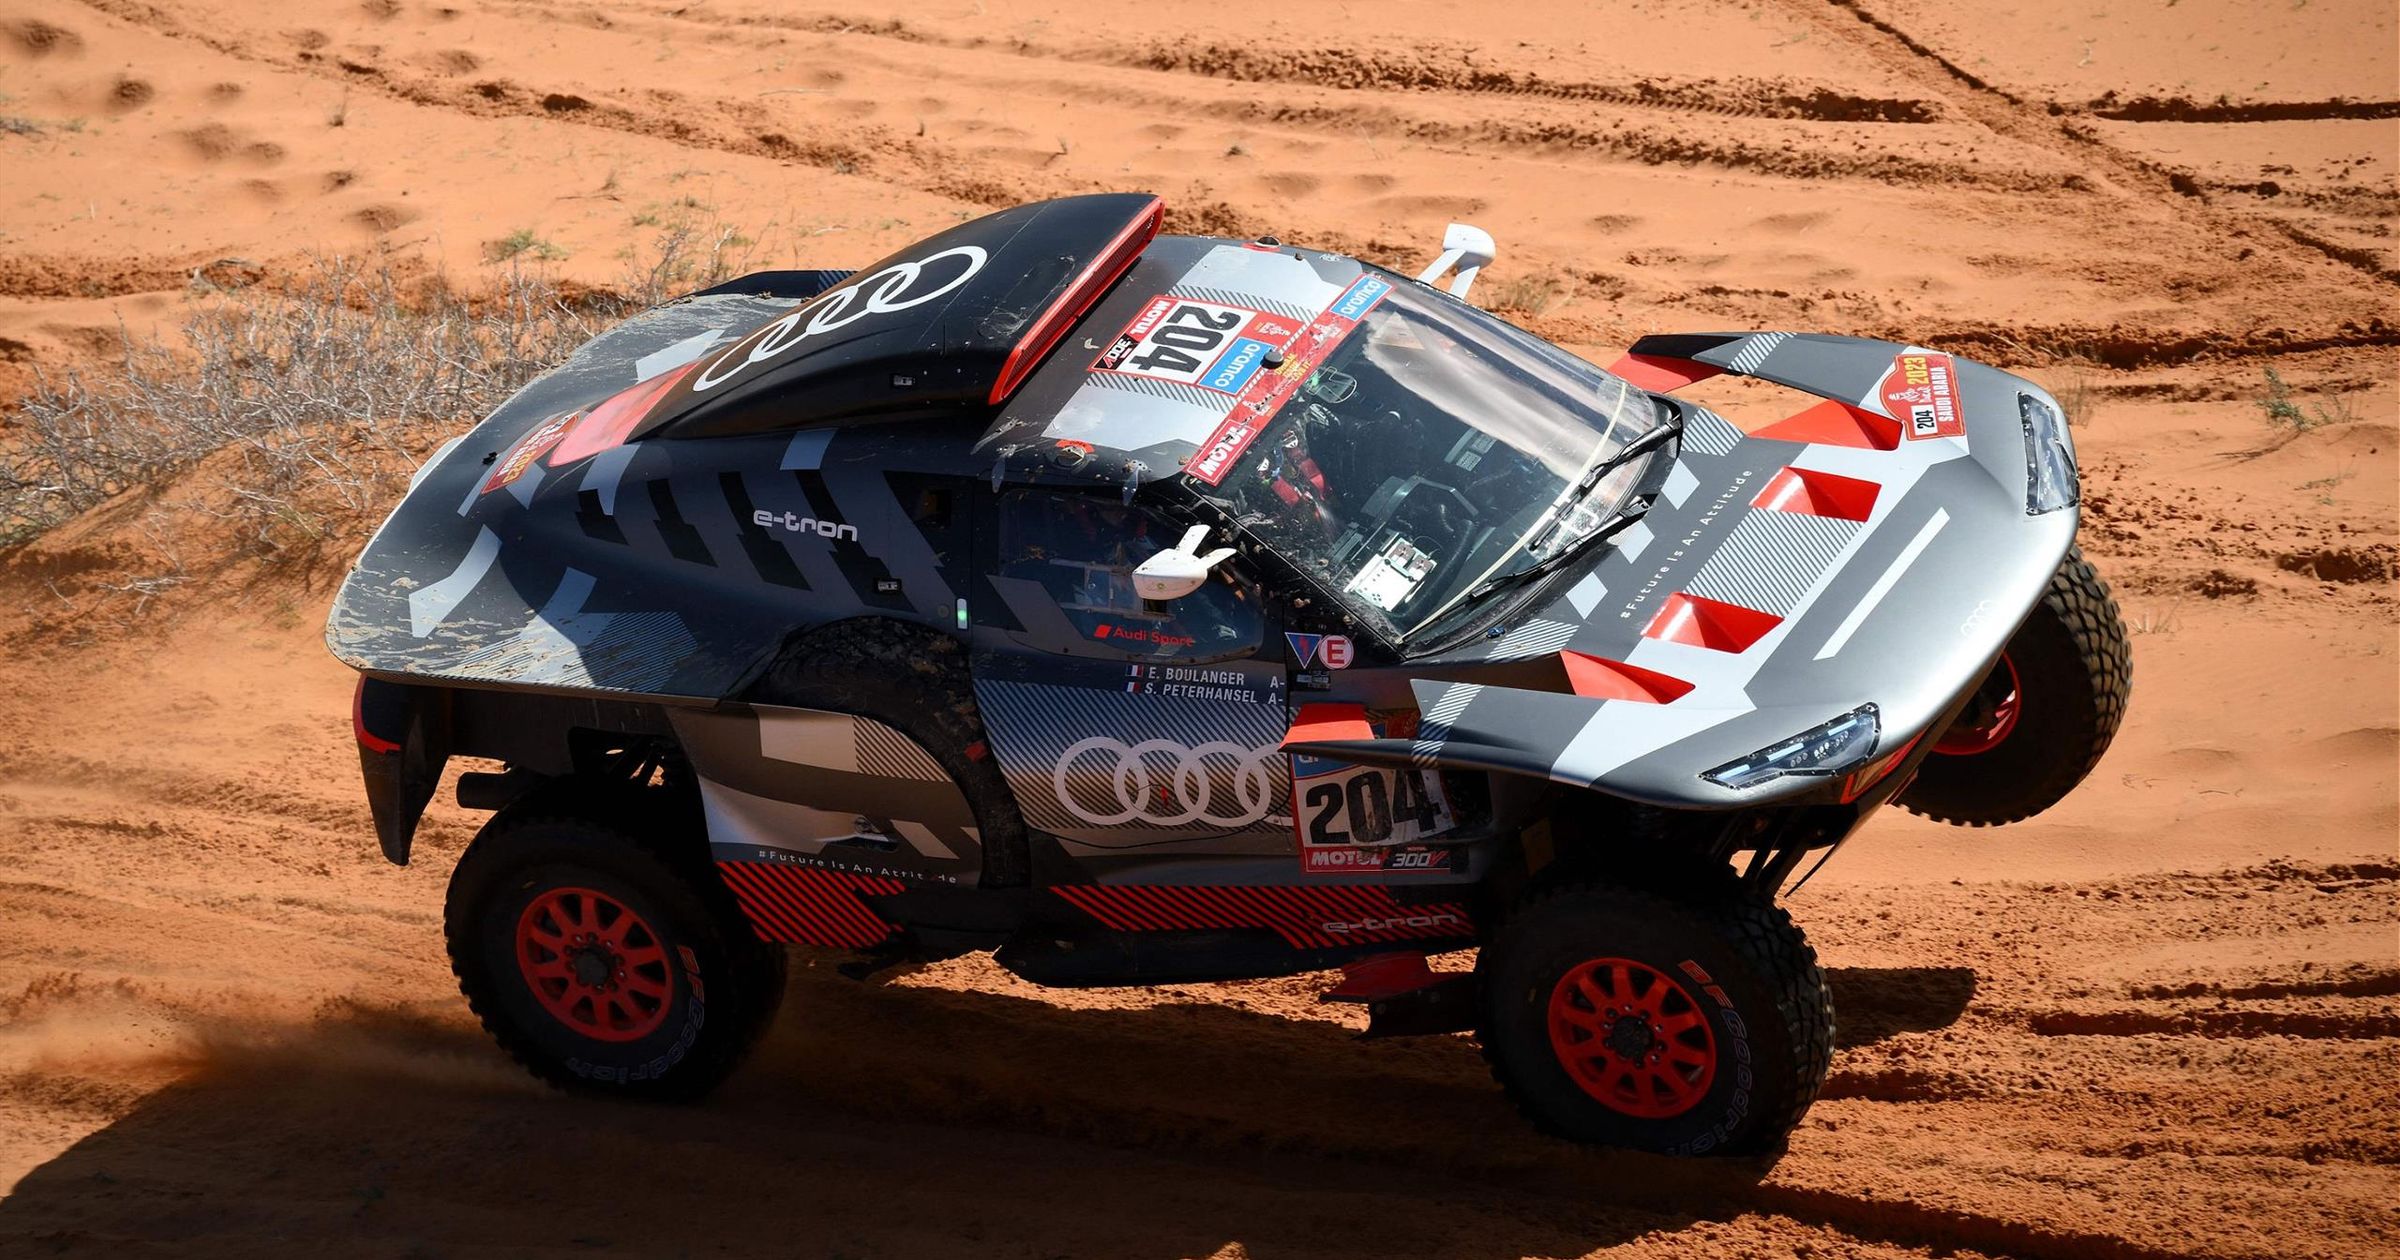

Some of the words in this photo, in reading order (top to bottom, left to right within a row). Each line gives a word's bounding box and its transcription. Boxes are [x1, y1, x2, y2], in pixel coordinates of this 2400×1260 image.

[1339, 279, 1381, 315] aramco
[1130, 299, 1170, 335] MOTUL
[1128, 304, 1241, 374] 204
[1215, 343, 1261, 387] aramco
[1903, 356, 1930, 385] 2023
[1929, 366, 1950, 396] ARABIA
[1914, 410, 1935, 429] 204
[1934, 397, 1954, 422] SAUDI
[1198, 425, 1249, 477] MOTUL
[752, 508, 859, 543] e-tron
[1620, 565, 1670, 619] #Future
[1666, 550, 1684, 563] Is
[1681, 529, 1702, 546] An
[1699, 470, 1753, 526] Attitude
[1113, 625, 1147, 642] Audi
[1151, 629, 1196, 648] Sport
[1326, 639, 1347, 665] E
[1148, 666, 1160, 679] E.
[1165, 667, 1245, 686] BOULANGER
[1144, 682, 1157, 695] S.
[1162, 683, 1258, 703] PETERHANSEL
[1305, 769, 1442, 844] 204
[759, 850, 825, 867] #Future
[831, 860, 845, 871] Is
[853, 863, 873, 874] An
[1311, 850, 1381, 866] MOTUL
[1392, 850, 1449, 868] 300V
[1322, 913, 1459, 934] e-tron
